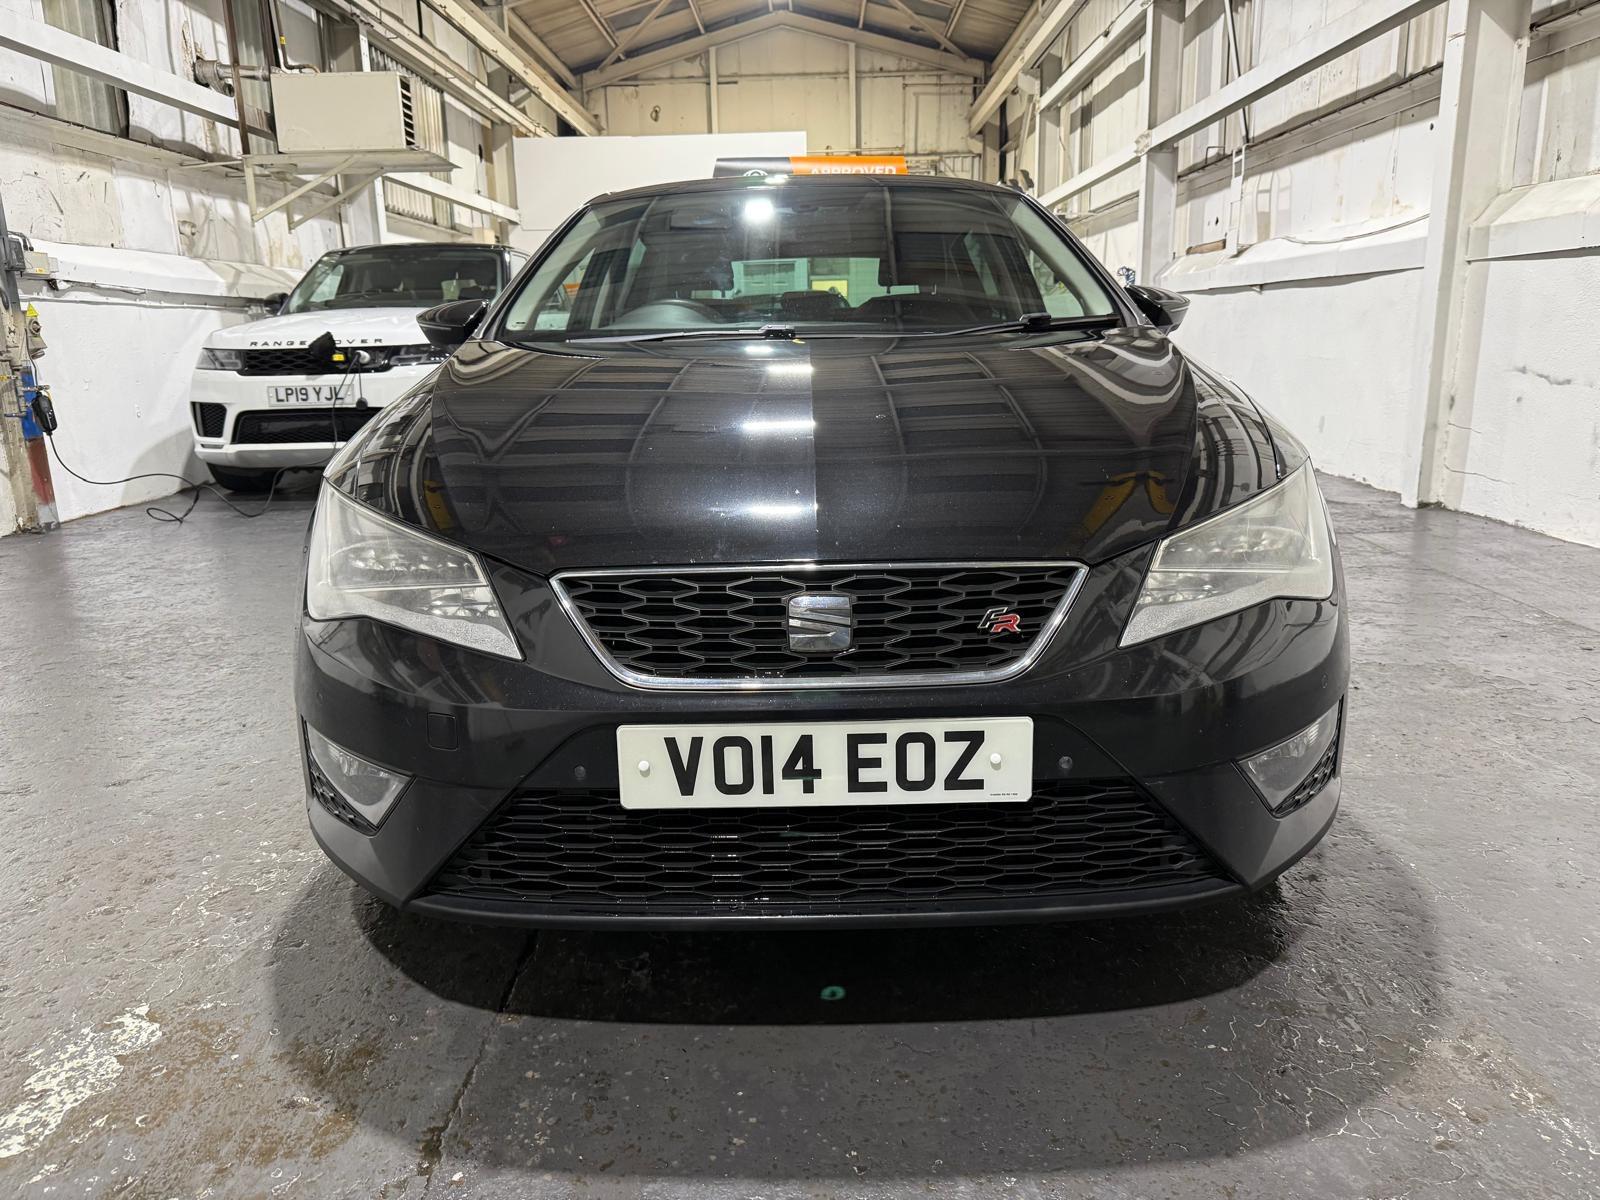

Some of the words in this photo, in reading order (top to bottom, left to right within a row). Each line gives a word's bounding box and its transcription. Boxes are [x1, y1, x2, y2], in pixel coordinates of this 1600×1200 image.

[275, 387, 309, 402] LP19
[313, 386, 344, 401] YJL
[977, 607, 1021, 632] FR
[664, 734, 822, 797] VO14
[846, 731, 986, 793] EOZ
